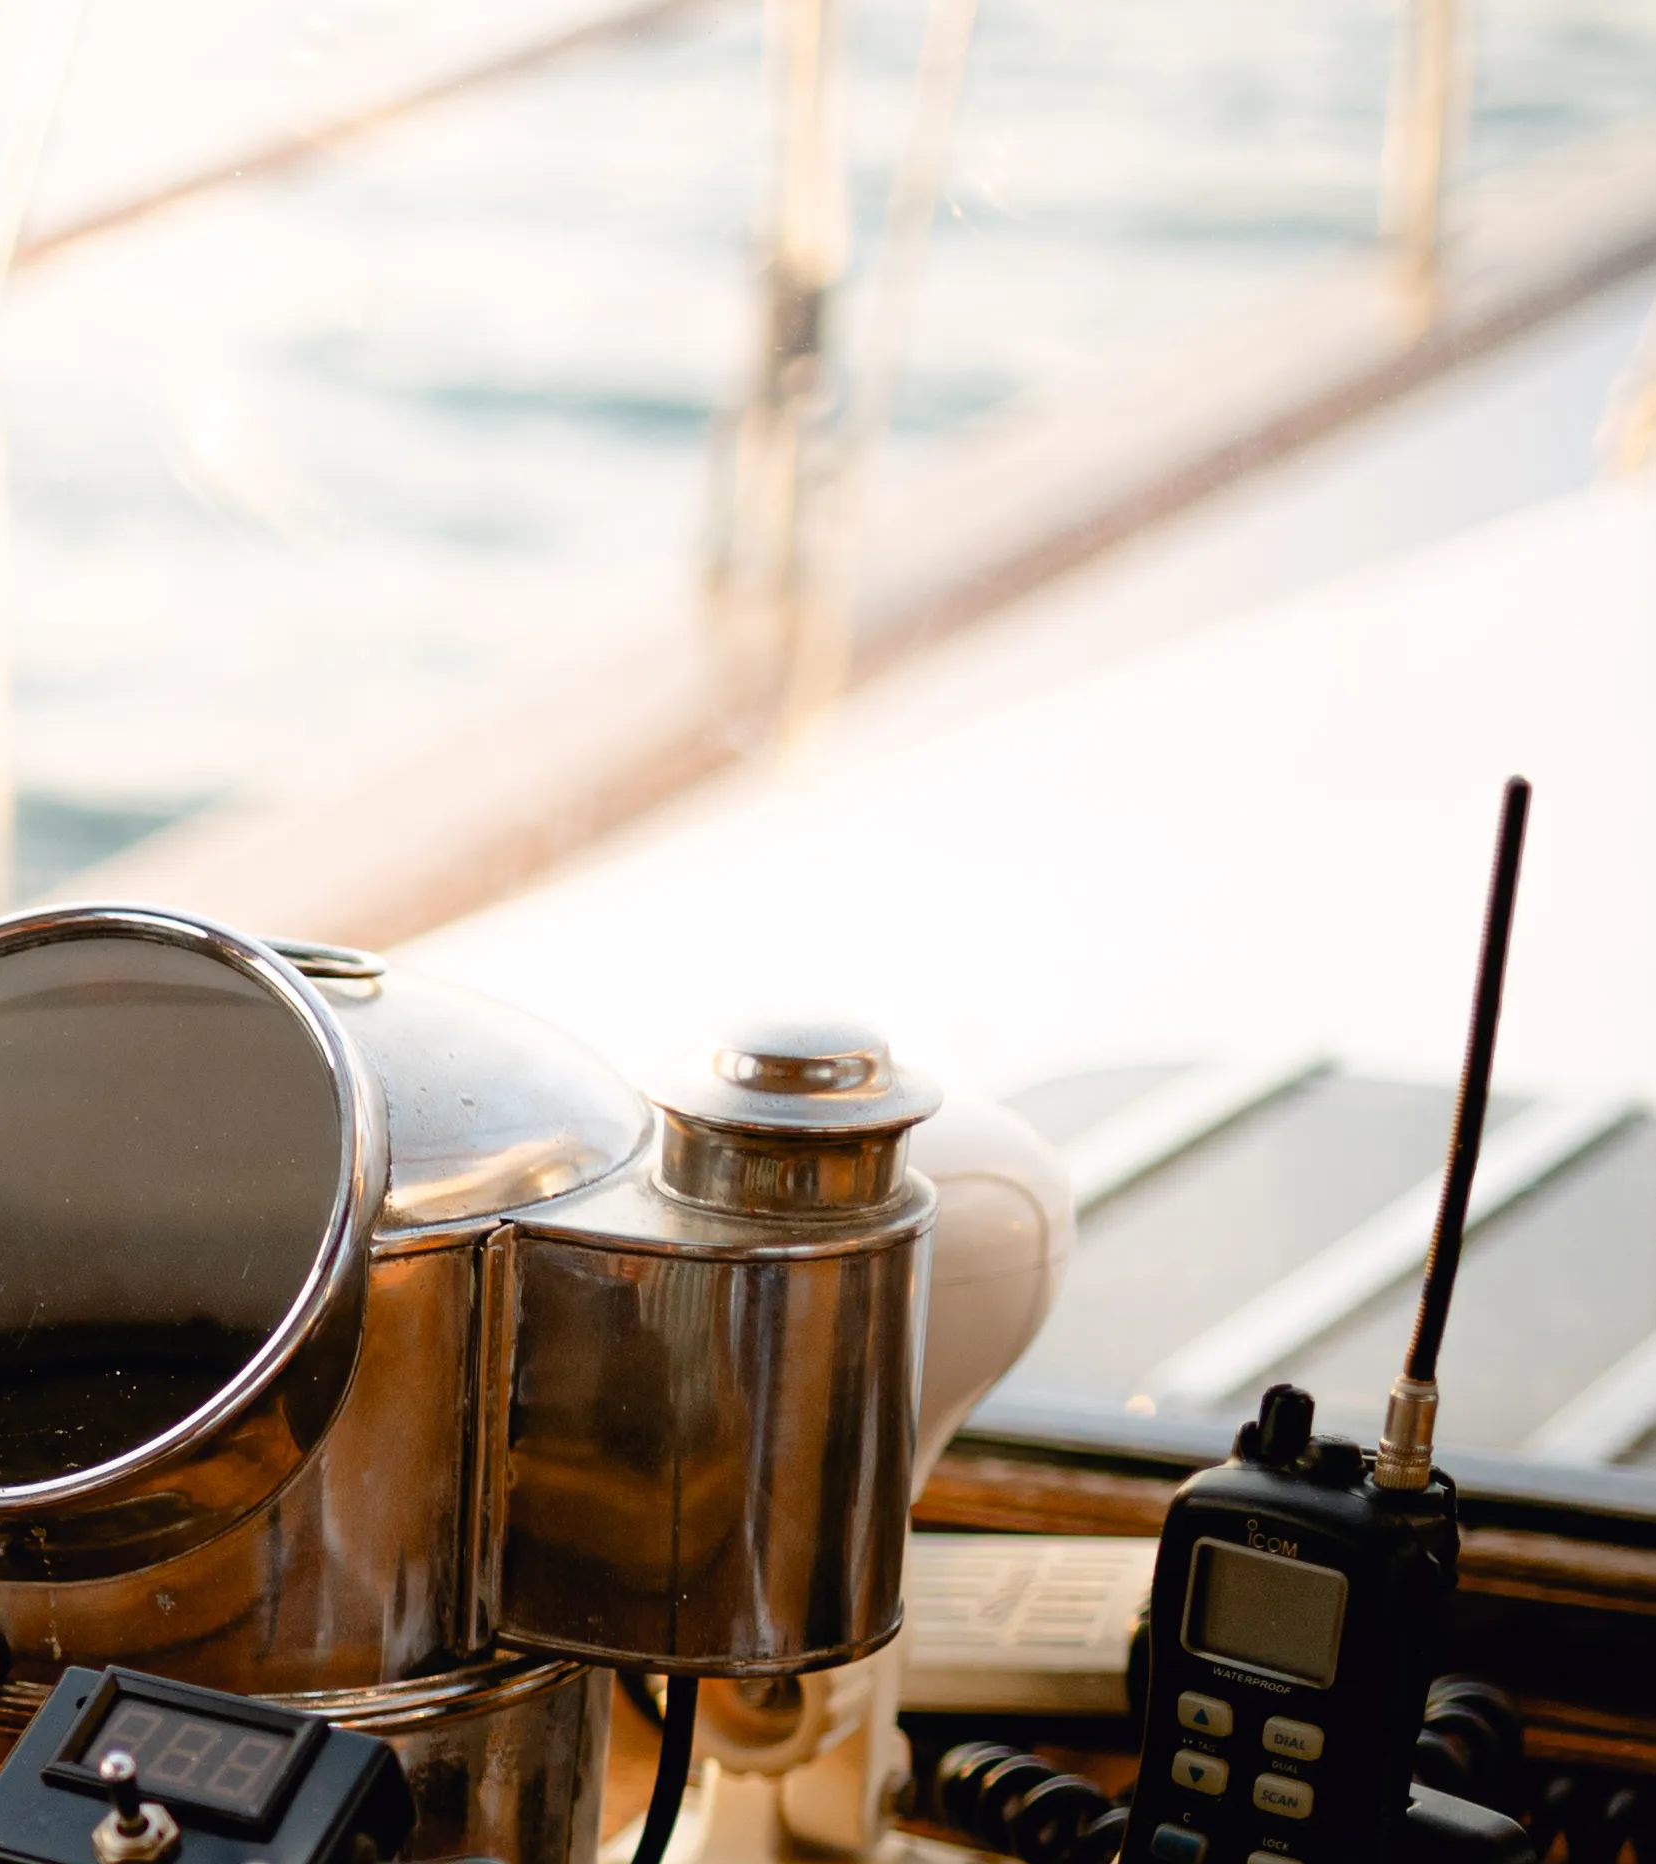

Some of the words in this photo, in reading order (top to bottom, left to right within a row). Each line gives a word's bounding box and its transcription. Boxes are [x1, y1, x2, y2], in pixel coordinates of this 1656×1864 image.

[1212, 1666, 1292, 1695] WATERPROOF
[1273, 1733, 1306, 1751] DIAL
[1271, 1760, 1299, 1774] DUAL
[1260, 1790, 1299, 1808] SCAN
[1182, 1811, 1192, 1823] C
[1262, 1837, 1292, 1852] LOCK
